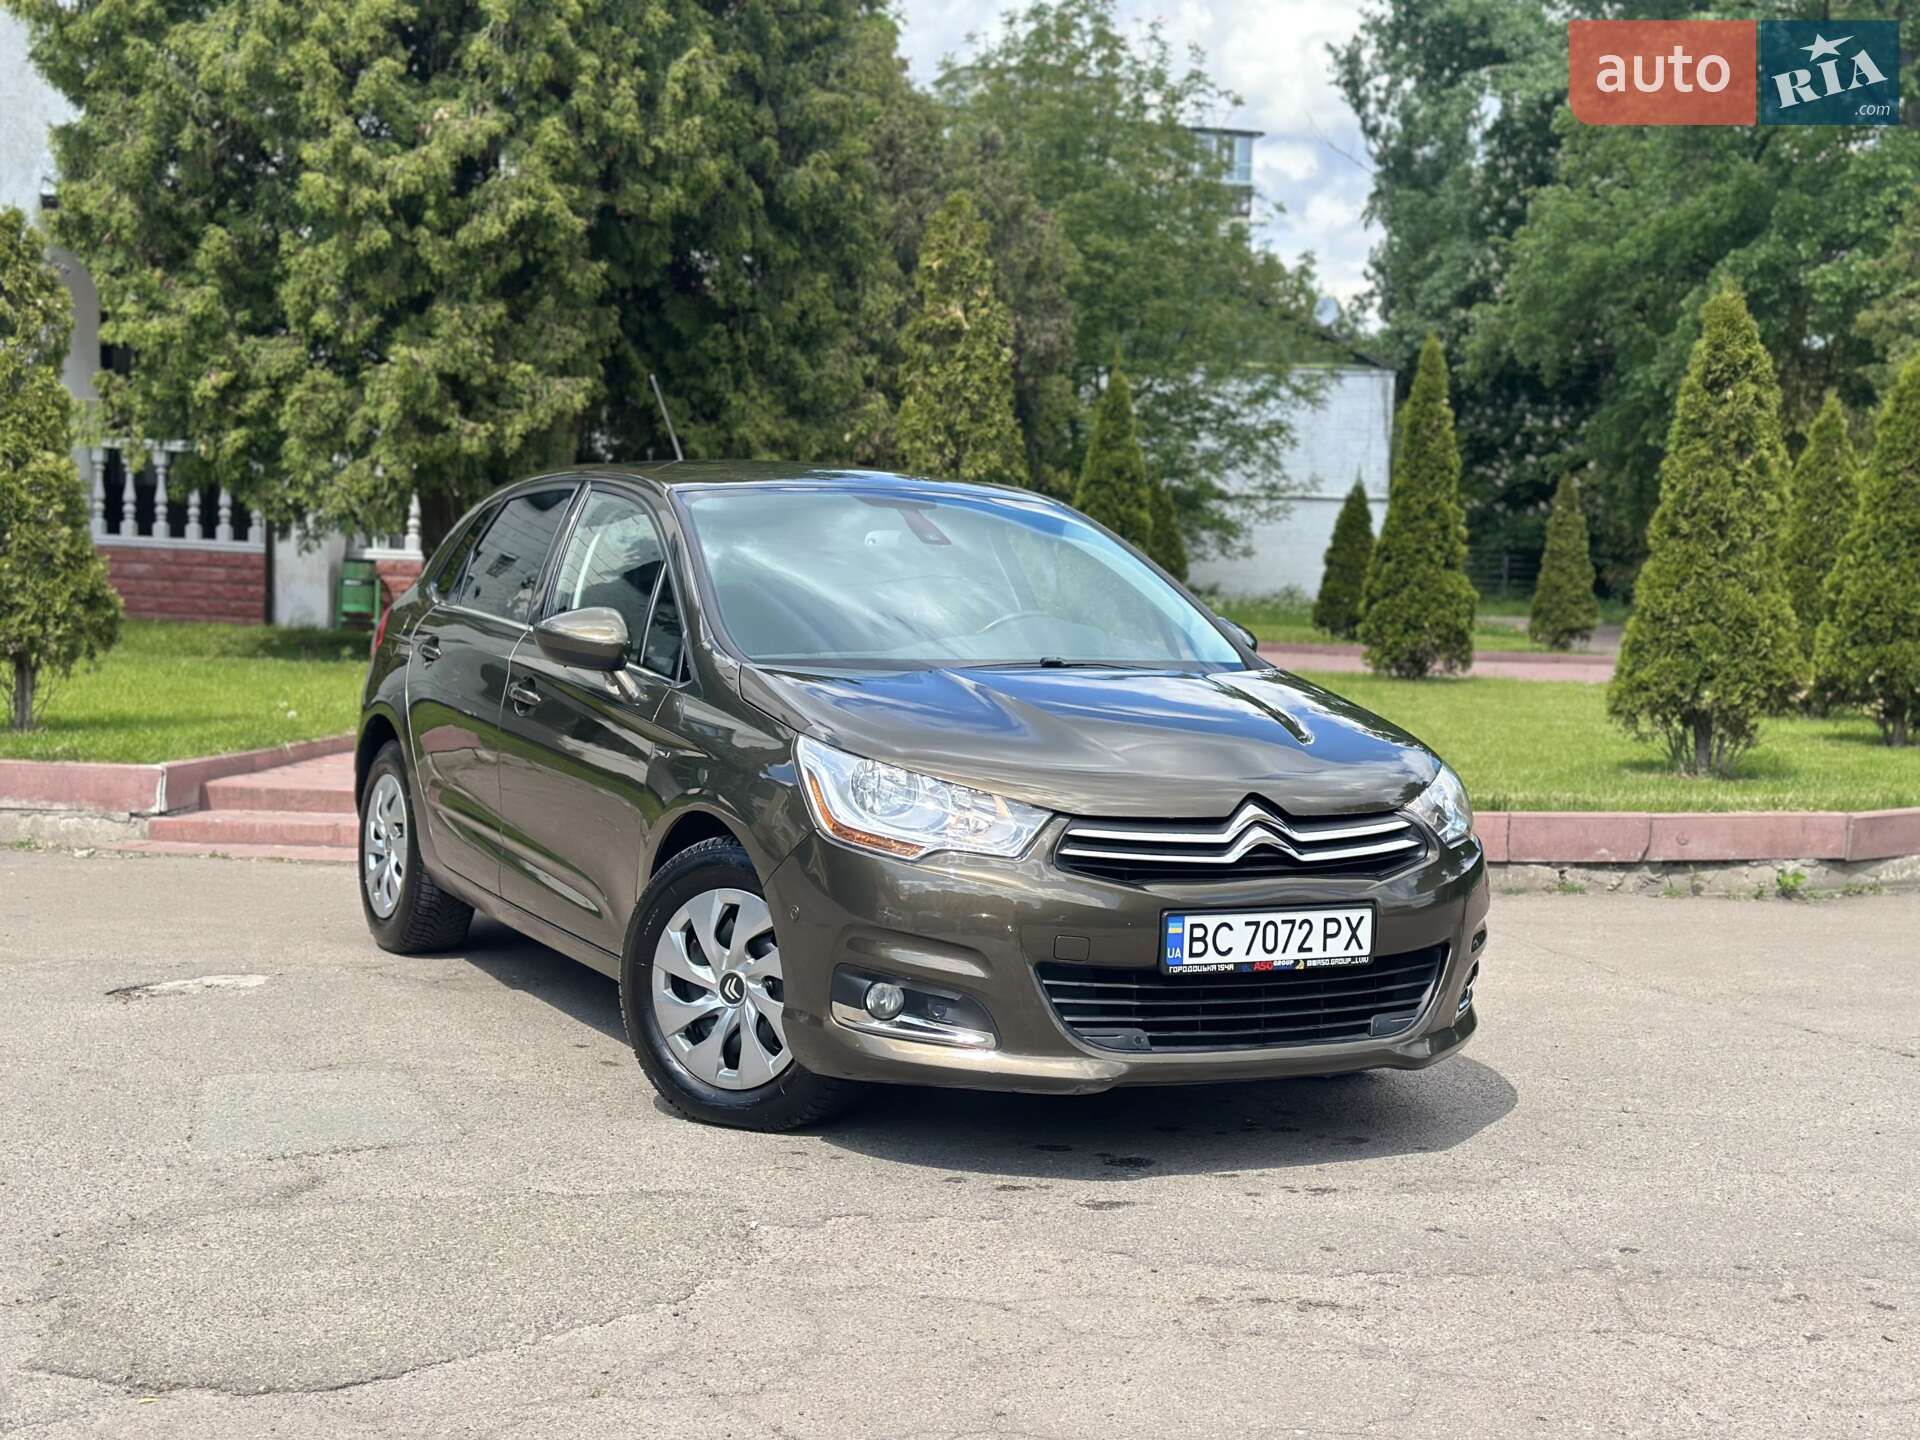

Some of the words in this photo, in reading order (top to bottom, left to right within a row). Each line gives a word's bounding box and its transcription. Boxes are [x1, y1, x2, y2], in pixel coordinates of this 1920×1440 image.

[1188, 922, 1234, 958] BC
[1245, 919, 1314, 956] 7072
[1323, 916, 1365, 952] PX
[1167, 947, 1182, 958] UA
[1273, 959, 1294, 967] GROUP
